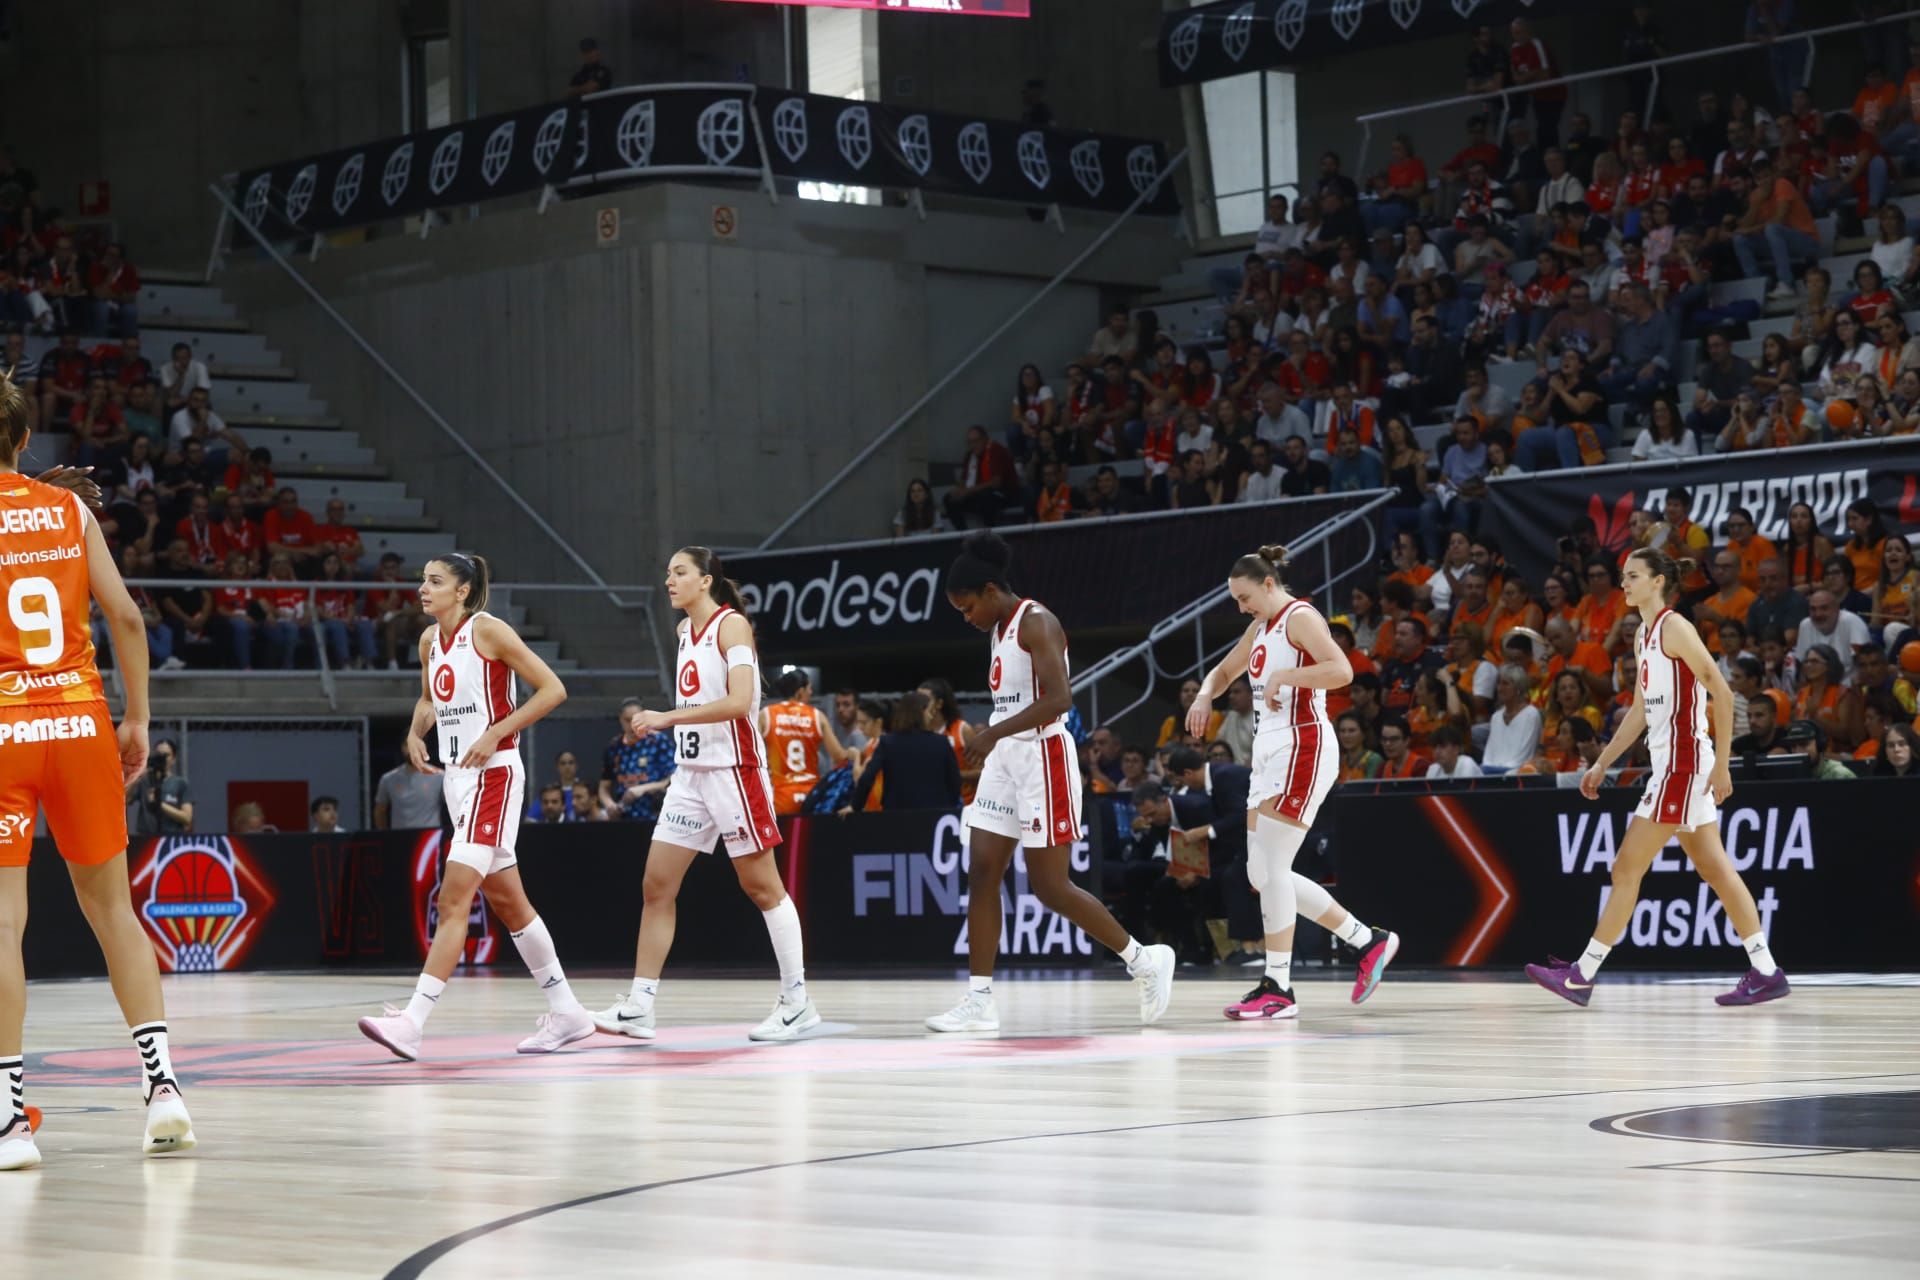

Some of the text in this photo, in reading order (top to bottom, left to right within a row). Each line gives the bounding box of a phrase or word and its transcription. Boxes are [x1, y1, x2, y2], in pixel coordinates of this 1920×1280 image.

[0, 543, 82, 571] uirónsalud
[8, 576, 65, 665] 9
[0, 714, 97, 746] PAMESA
[680, 731, 700, 759] 13
[787, 740, 807, 772] 8
[665, 812, 703, 830] Silken
[977, 797, 1014, 816] Silken
[1558, 807, 1815, 873] VAECIA
